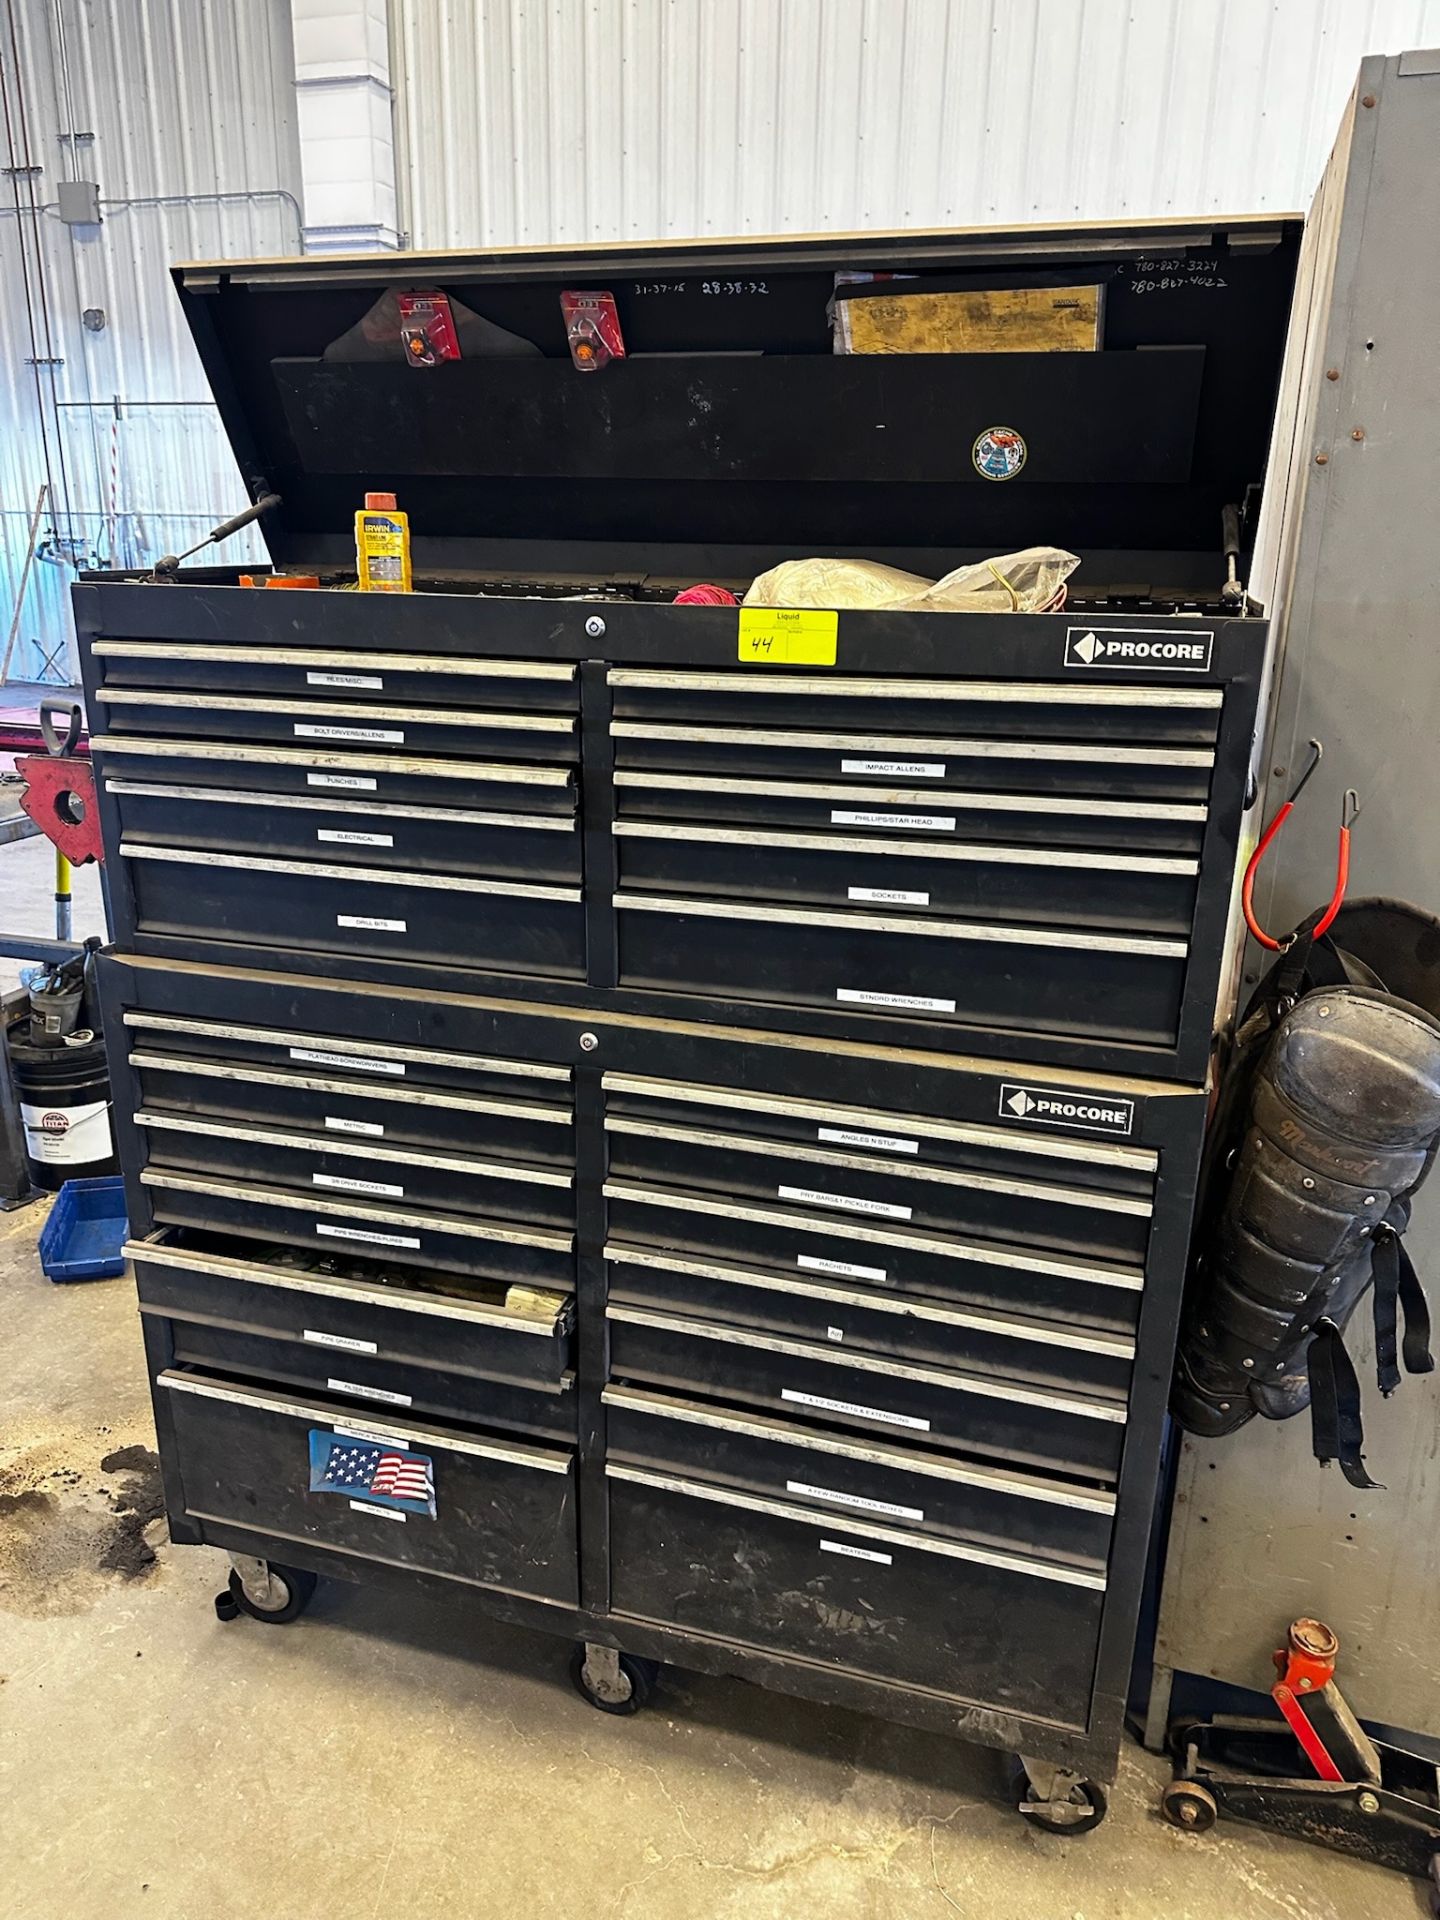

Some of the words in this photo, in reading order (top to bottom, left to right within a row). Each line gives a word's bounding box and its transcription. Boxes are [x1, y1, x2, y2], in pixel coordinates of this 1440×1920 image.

[365, 524, 390, 533] IRWIN
[777, 612, 800, 621] Liquid
[752, 636, 774, 653] 44
[1106, 641, 1205, 660] PROCORE
[314, 727, 331, 735] BOLT
[331, 729, 385, 739] DRIVERS/ALLENS
[865, 763, 893, 771] IMPACT
[896, 765, 926, 773] ALLENS
[327, 777, 358, 786] PUNCHES
[855, 814, 910, 824] PHILLIPS/STAR
[911, 818, 933, 826] HEAD
[337, 833, 374, 842] ELECTRICAL
[871, 891, 907, 900] SOCKETS
[356, 919, 373, 927] DRILL
[859, 993, 890, 1003] STNDRD
[891, 996, 933, 1007] WRENCHES
[308, 1052, 338, 1063] FLATHEAD
[1037, 1100, 1126, 1124] PROCORE
[343, 1121, 366, 1131] METRIC
[840, 1133, 870, 1144] ANGLES
[340, 1179, 358, 1188] DRIVE
[358, 1182, 387, 1192] SOCKETS
[800, 1191, 814, 1200] PRY
[844, 1199, 870, 1209] PICKLE
[871, 1203, 891, 1212] FORK
[334, 1228, 347, 1236] PIPE
[826, 1401, 859, 1414] SOCKETS
[865, 1410, 910, 1424] EXTENSIONS
